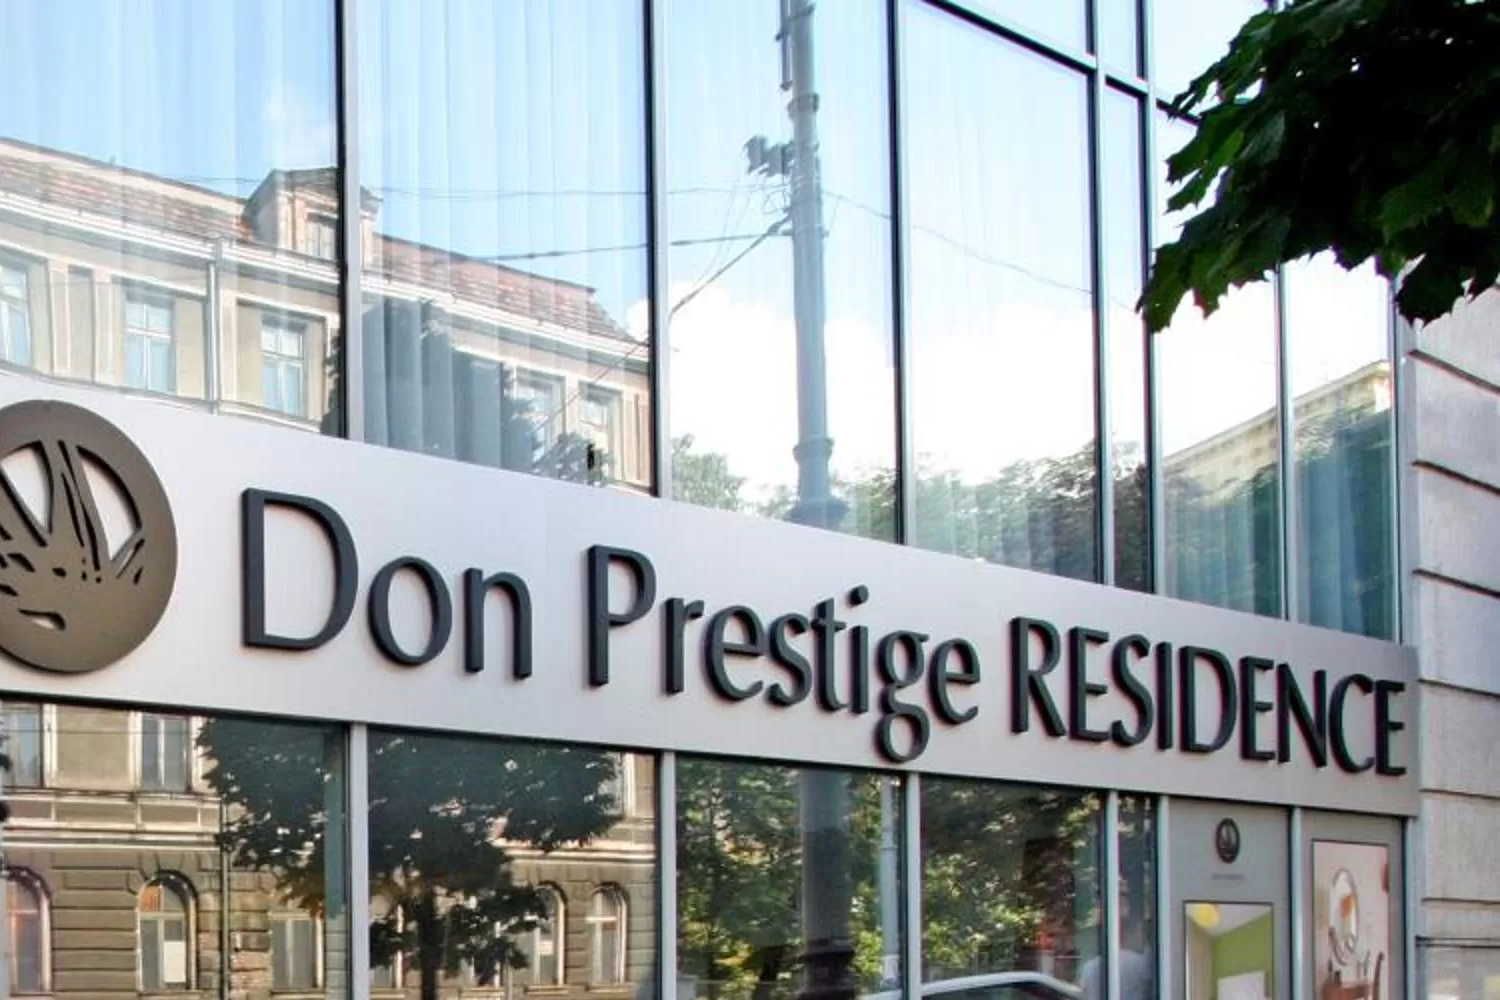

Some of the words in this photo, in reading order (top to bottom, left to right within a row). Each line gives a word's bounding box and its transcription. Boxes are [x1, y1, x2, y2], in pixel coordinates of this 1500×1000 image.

[240, 487, 533, 682] Don
[587, 545, 980, 765] Prestige
[1009, 617, 1407, 776] RESIDENCE
